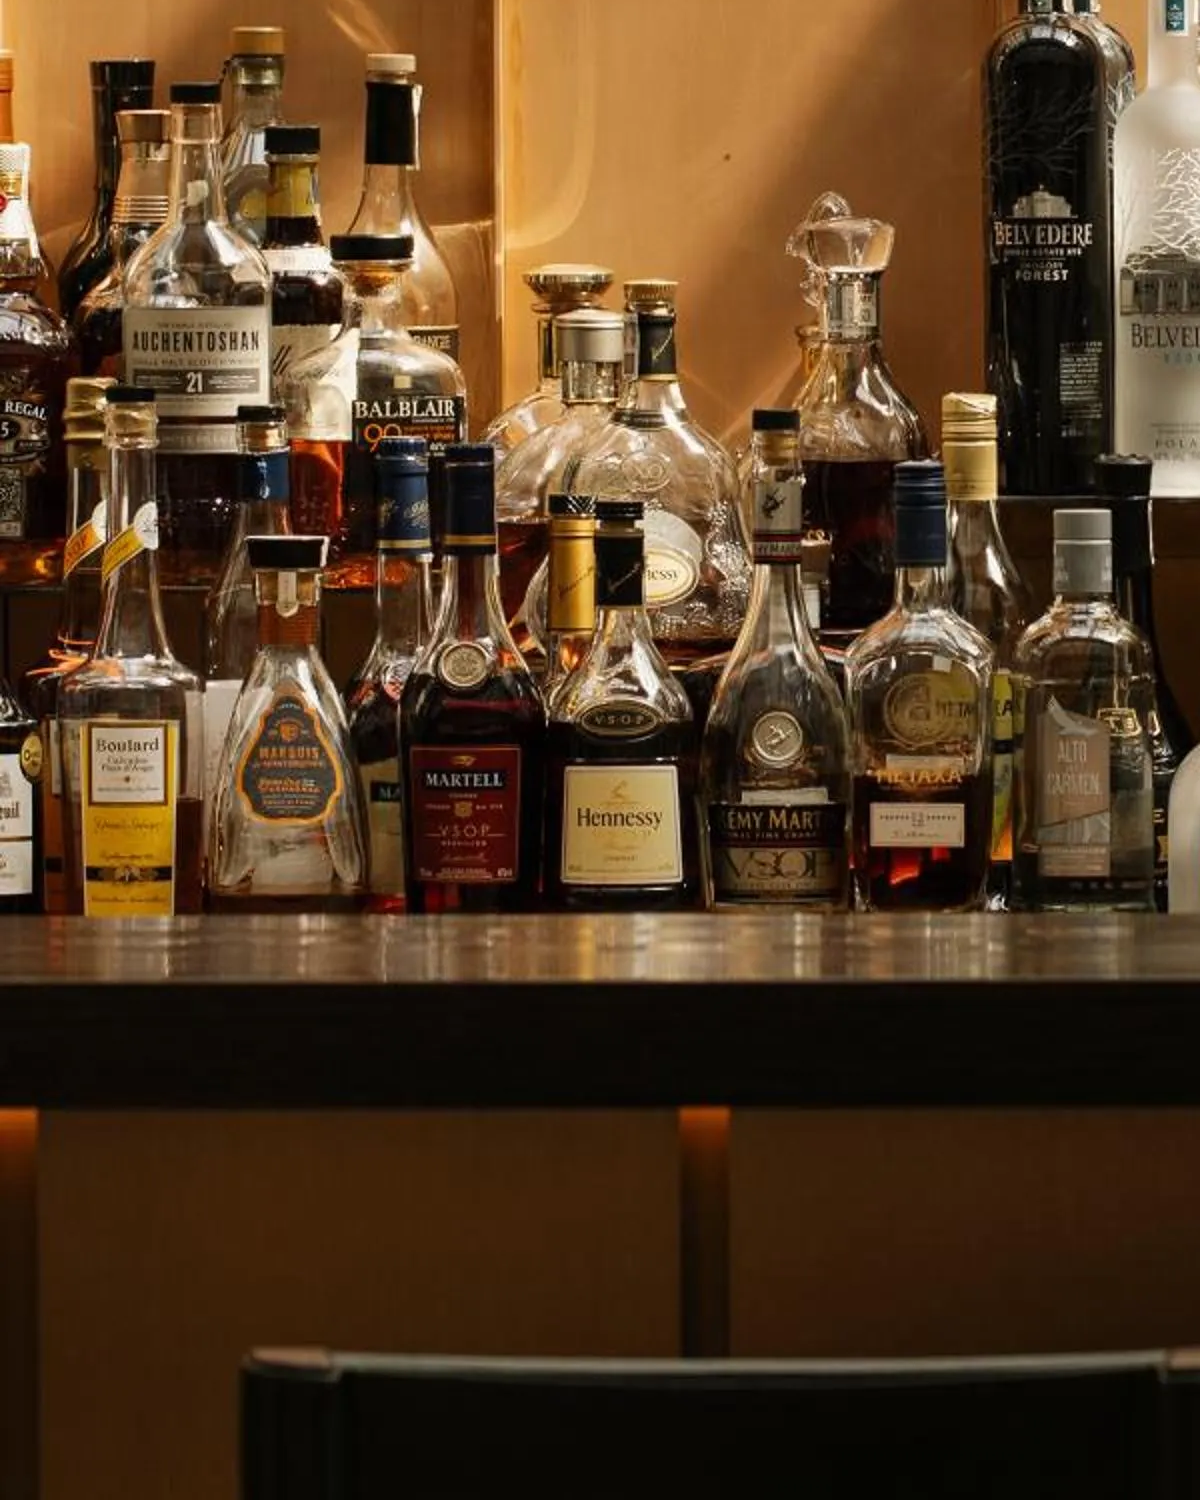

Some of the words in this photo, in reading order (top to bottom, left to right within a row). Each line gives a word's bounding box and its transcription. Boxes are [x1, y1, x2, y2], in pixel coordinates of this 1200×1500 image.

[994, 221, 1093, 247] BELVEDERE
[1015, 269, 1069, 281] FOREST
[132, 331, 259, 353] AUCHENTOSHAN
[186, 371, 203, 393] 21
[4, 400, 47, 420] REGAL
[354, 399, 455, 419] BALBLAIR
[95, 737, 160, 752] Boulard
[1057, 740, 1088, 763] ALTO
[426, 771, 503, 787] MARTELL
[1046, 772, 1100, 796] CARMEN
[576, 807, 663, 831] Hennessy
